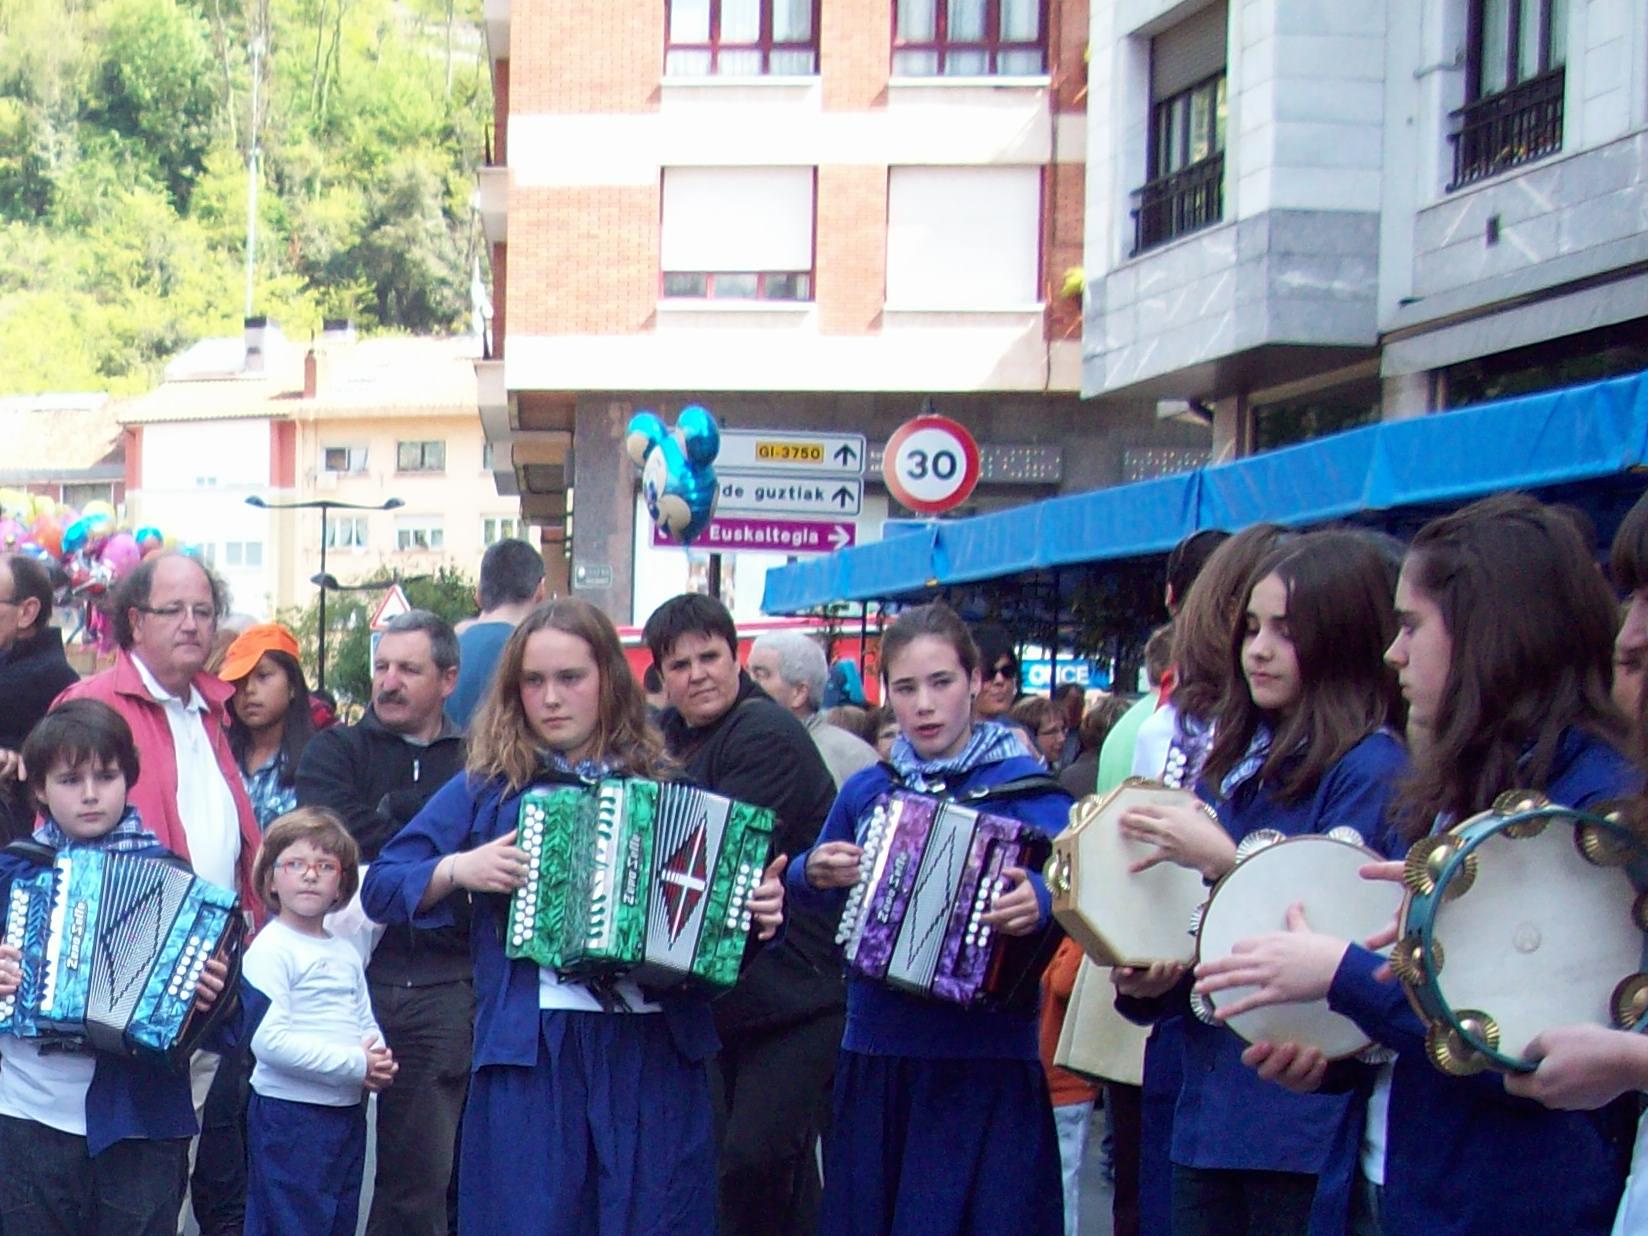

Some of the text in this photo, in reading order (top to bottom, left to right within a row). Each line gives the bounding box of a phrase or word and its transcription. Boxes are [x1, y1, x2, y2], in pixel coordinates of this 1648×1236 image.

[759, 446, 821, 460] GI-3750
[907, 450, 957, 481] 30
[754, 486, 825, 502] guztiak
[709, 524, 820, 546] Euskaltegia
